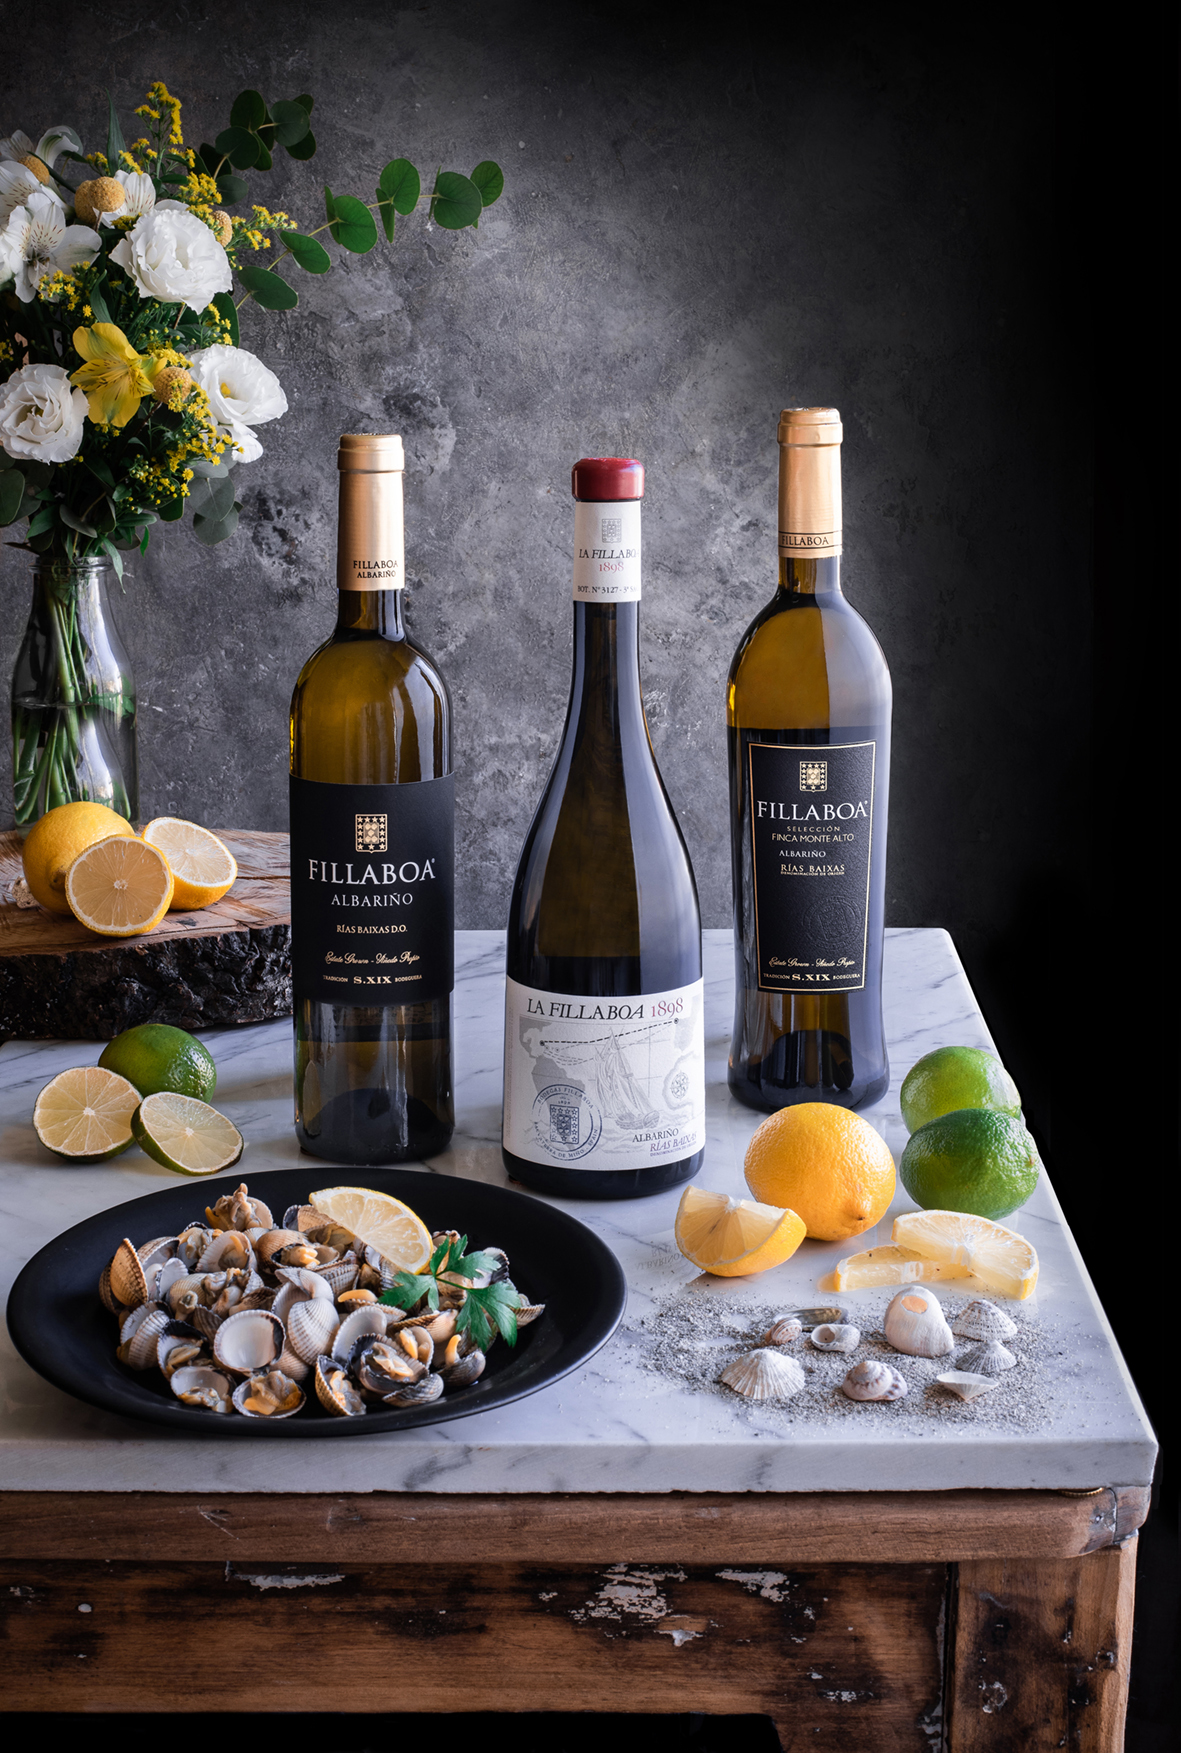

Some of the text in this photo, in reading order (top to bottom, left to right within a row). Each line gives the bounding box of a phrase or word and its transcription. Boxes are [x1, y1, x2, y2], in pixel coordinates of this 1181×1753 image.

[781, 535, 829, 546] FILLABOA
[579, 549, 639, 559] LA FILLABO
[353, 560, 398, 569] FILLABOA
[599, 562, 624, 574] 1898
[357, 570, 396, 578] ALBARIÑO
[772, 832, 855, 843] FINCA MONTE ALTO
[779, 849, 826, 858] ALBARIÑO
[781, 863, 845, 873] RÍAS BAIXAS
[331, 892, 413, 907] ALBARIÑO
[336, 924, 356, 933] RÍAS
[358, 925, 390, 934] BAIXAS
[527, 997, 684, 1020] LA FILLABOA 1898
[632, 1128, 679, 1143] ALBARIÑO
[650, 1140, 672, 1152] RÍAS
